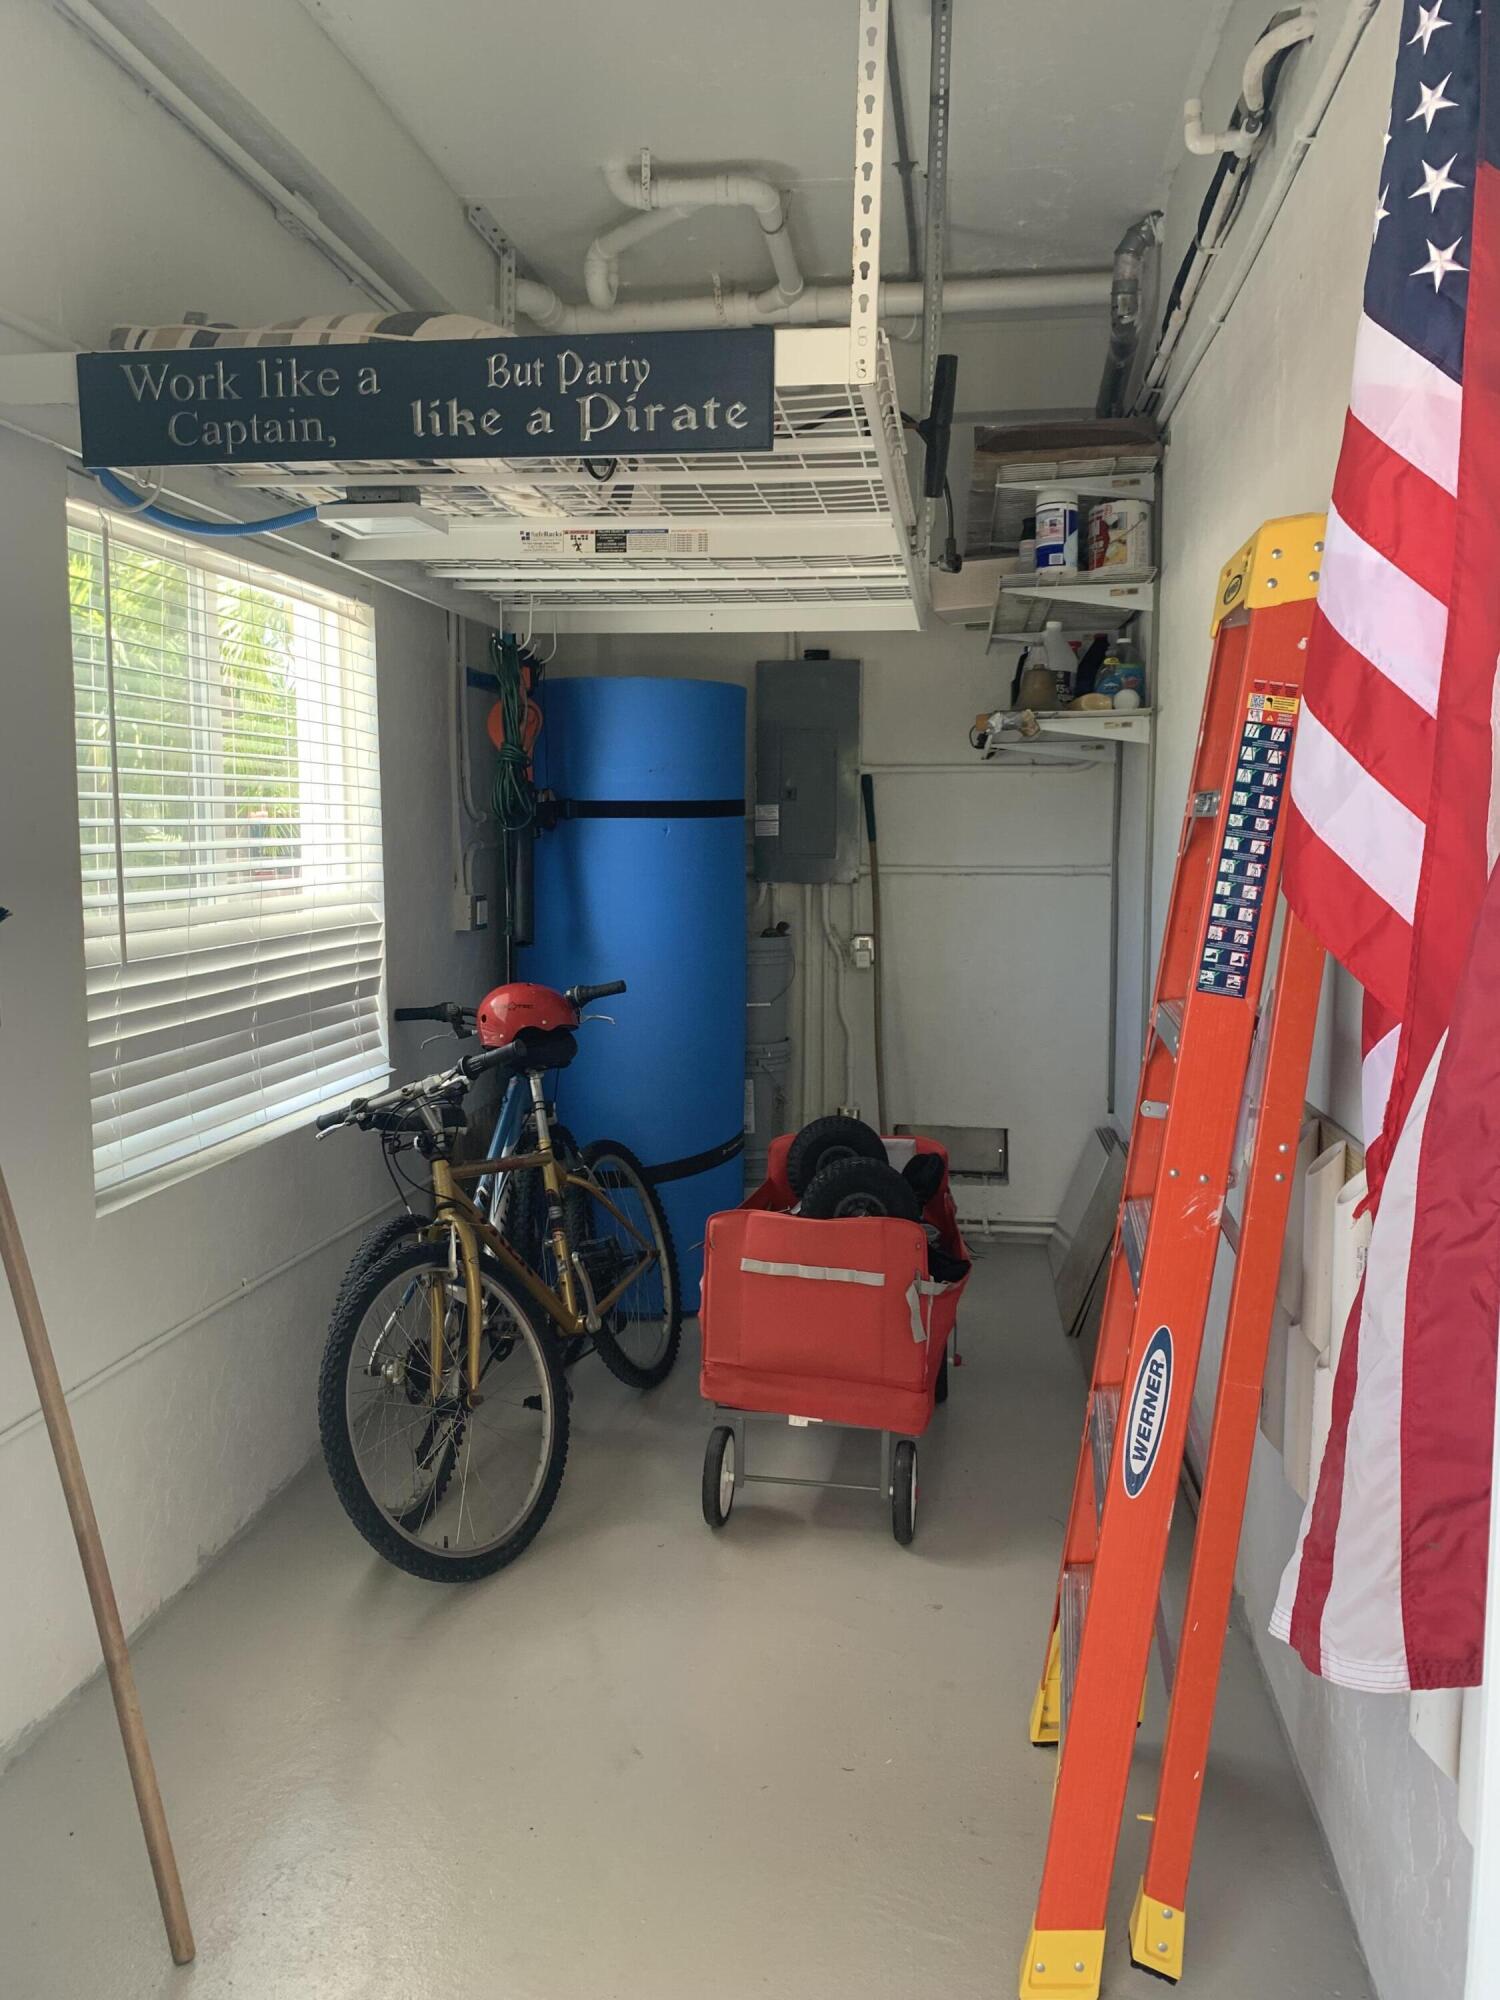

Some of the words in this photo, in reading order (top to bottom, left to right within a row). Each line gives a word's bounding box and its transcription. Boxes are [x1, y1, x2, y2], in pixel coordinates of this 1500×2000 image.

[120, 360, 243, 402] Work
[258, 358, 341, 398] like
[358, 366, 382, 395] a
[486, 352, 545, 389] But
[557, 349, 651, 394] Party
[168, 407, 337, 455] Captain,
[410, 397, 503, 437] like
[526, 406, 554, 435] a
[576, 392, 749, 441] Pirate
[1132, 1358, 1165, 1462] WERNER
